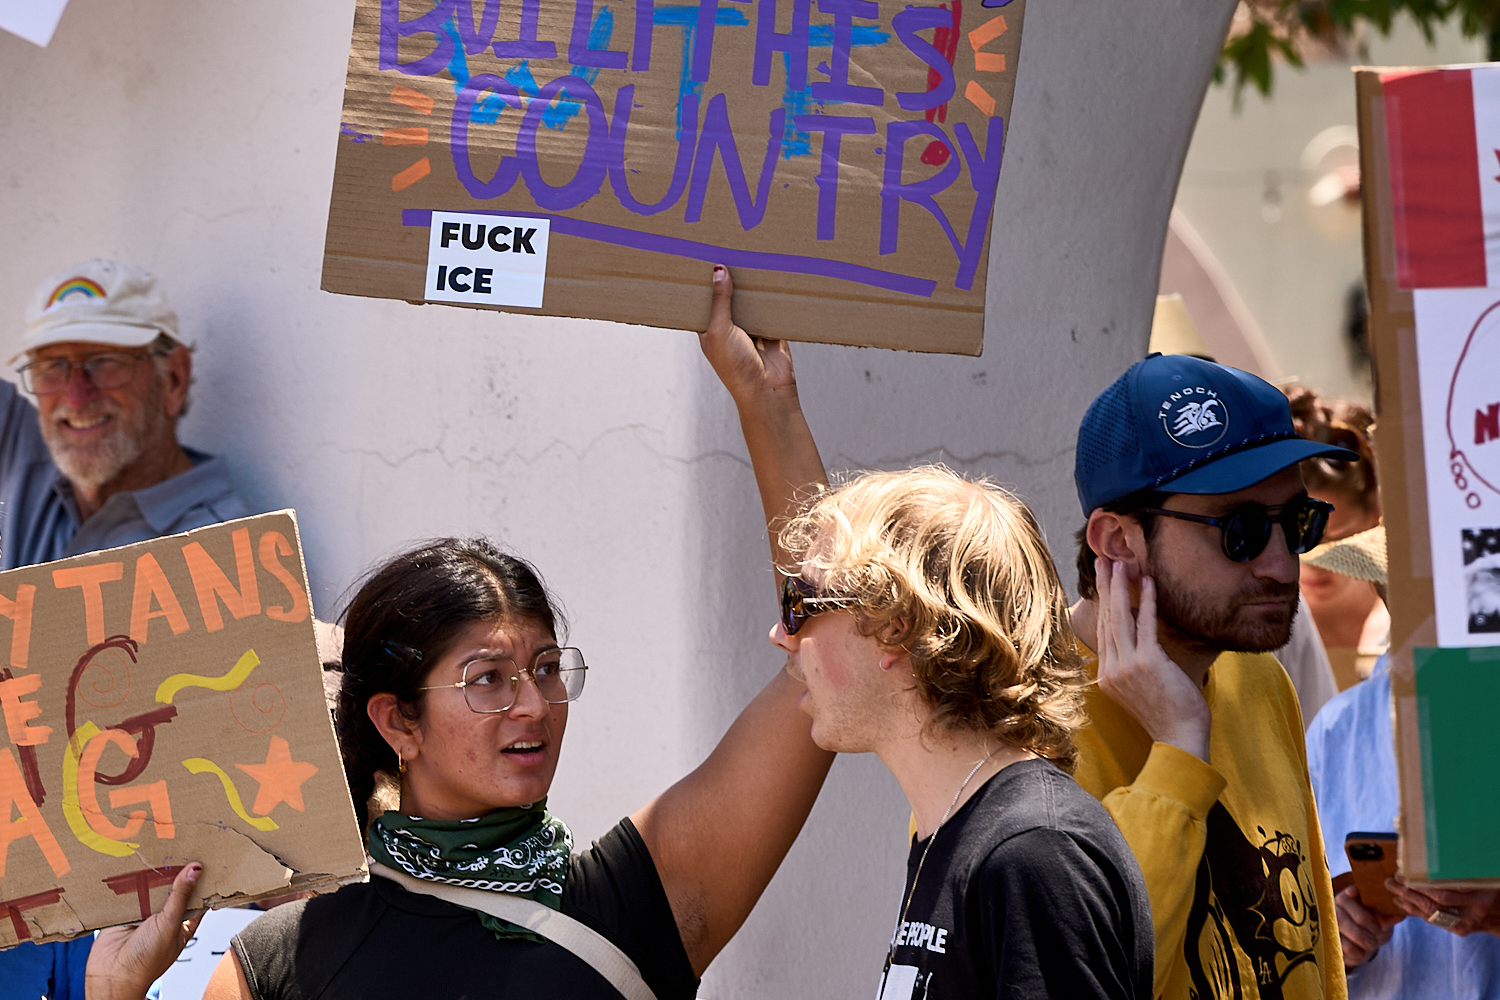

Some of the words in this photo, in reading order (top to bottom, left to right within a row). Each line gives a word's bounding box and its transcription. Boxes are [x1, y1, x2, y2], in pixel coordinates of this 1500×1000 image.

[450, 73, 1004, 291] COUNTRY
[440, 222, 537, 256] FUCK
[436, 265, 493, 296] ICE
[1158, 386, 1218, 419] TENOCH
[52, 528, 311, 646] TANS
